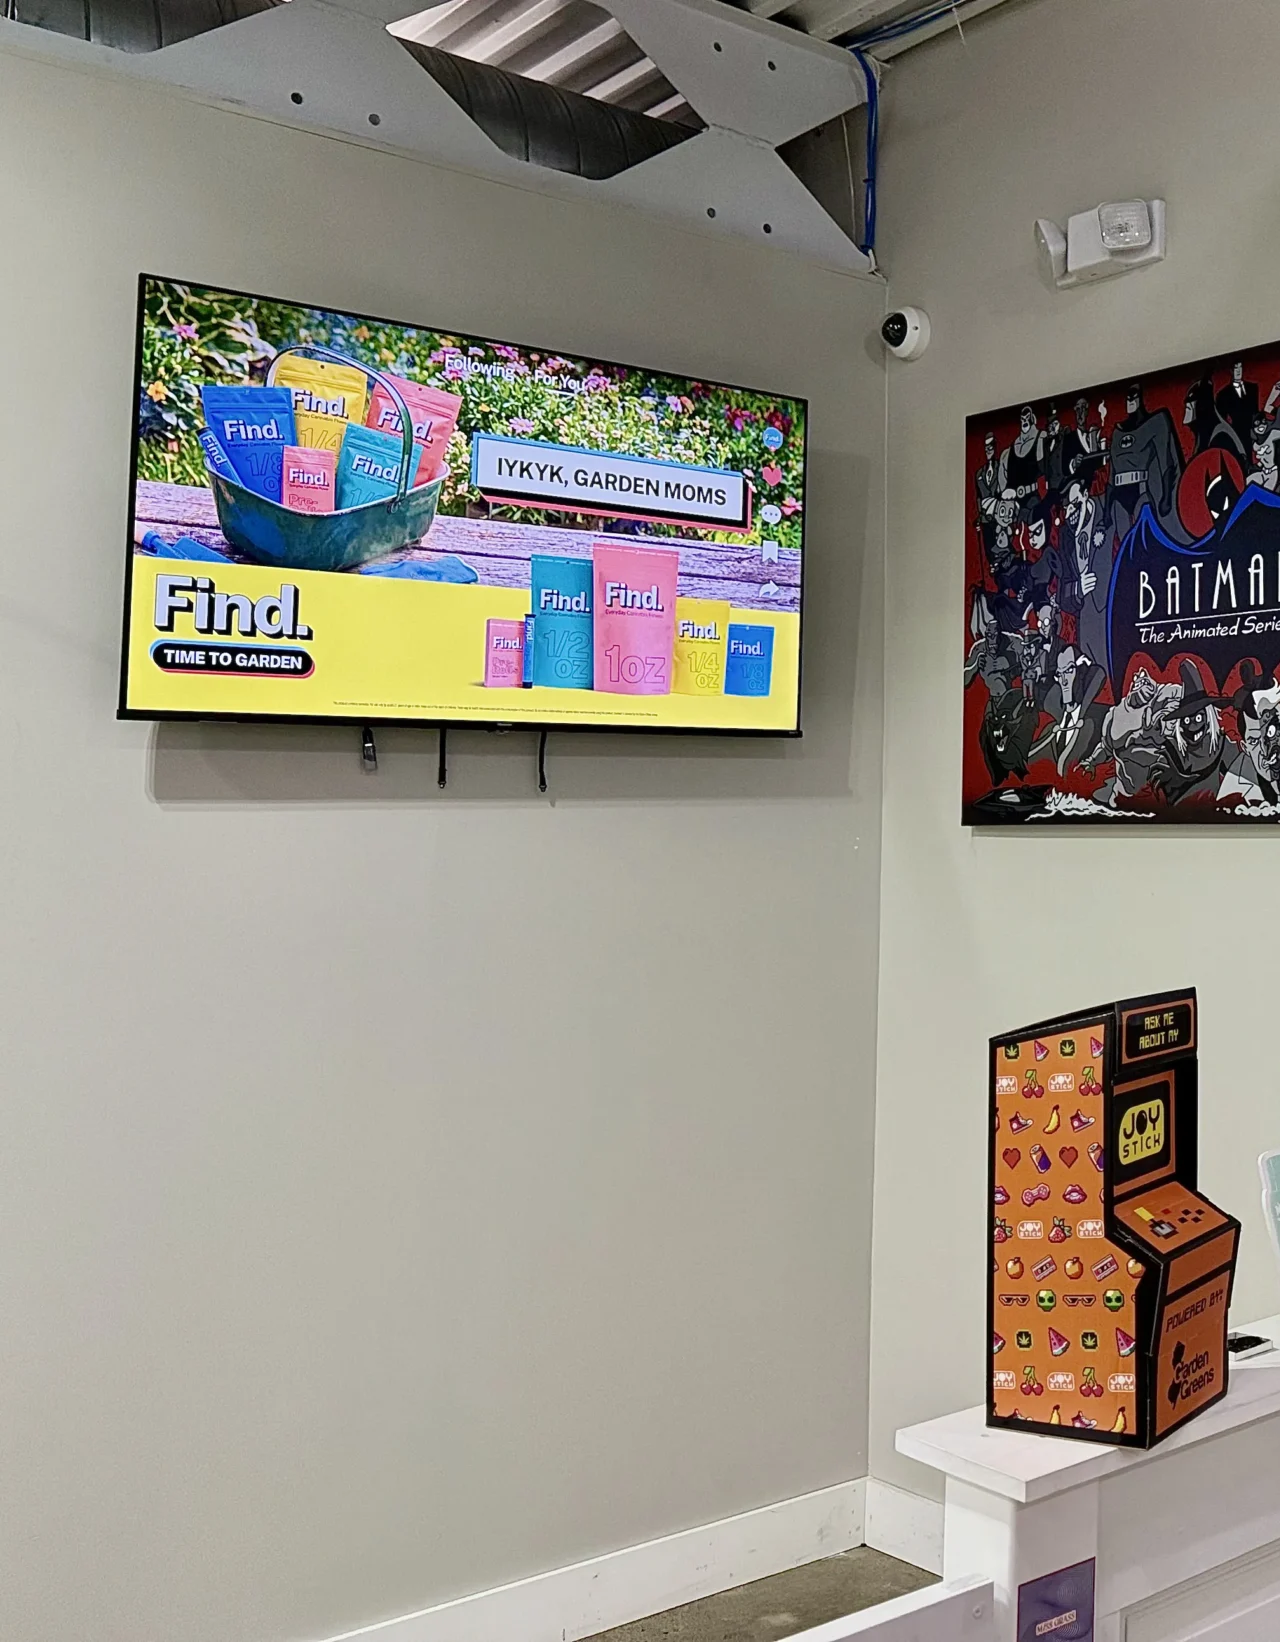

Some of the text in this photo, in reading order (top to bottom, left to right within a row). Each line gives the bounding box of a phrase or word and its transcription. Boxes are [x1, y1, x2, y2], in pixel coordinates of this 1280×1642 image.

[444, 354, 515, 382] Following
[534, 369, 586, 392] For You
[291, 387, 349, 420] Find.
[224, 419, 284, 442] Find.
[378, 407, 433, 443] Fid.
[289, 468, 329, 488] Find.
[497, 457, 727, 506] IYKYK, GARDEN MOMS
[154, 573, 313, 641] Find.
[539, 588, 592, 613] Find.
[605, 582, 664, 611] Find.
[678, 619, 720, 641] Find.
[1139, 627, 1166, 644] The
[1167, 618, 1241, 644] Animated
[493, 636, 523, 650] Find.
[543, 630, 590, 659] 1/2
[730, 639, 764, 656] Find.
[163, 649, 303, 669] TIME TO GARDEN
[687, 651, 719, 674] 1/4
[1144, 1012, 1175, 1030] ASK ME
[1139, 1032, 1166, 1050] ABOUT
[1050, 1075, 1072, 1085] JOY
[1123, 1104, 1161, 1140] JOY
[1123, 1132, 1161, 1159] STICK
[1019, 1223, 1041, 1232] JOY
[1079, 1221, 1102, 1231] JOY
[1166, 1298, 1207, 1333] POWERED
[1174, 1350, 1209, 1381] Garden
[1050, 1374, 1072, 1383] JOY
[1110, 1375, 1133, 1385] JOY
[1180, 1367, 1215, 1401] Greens
